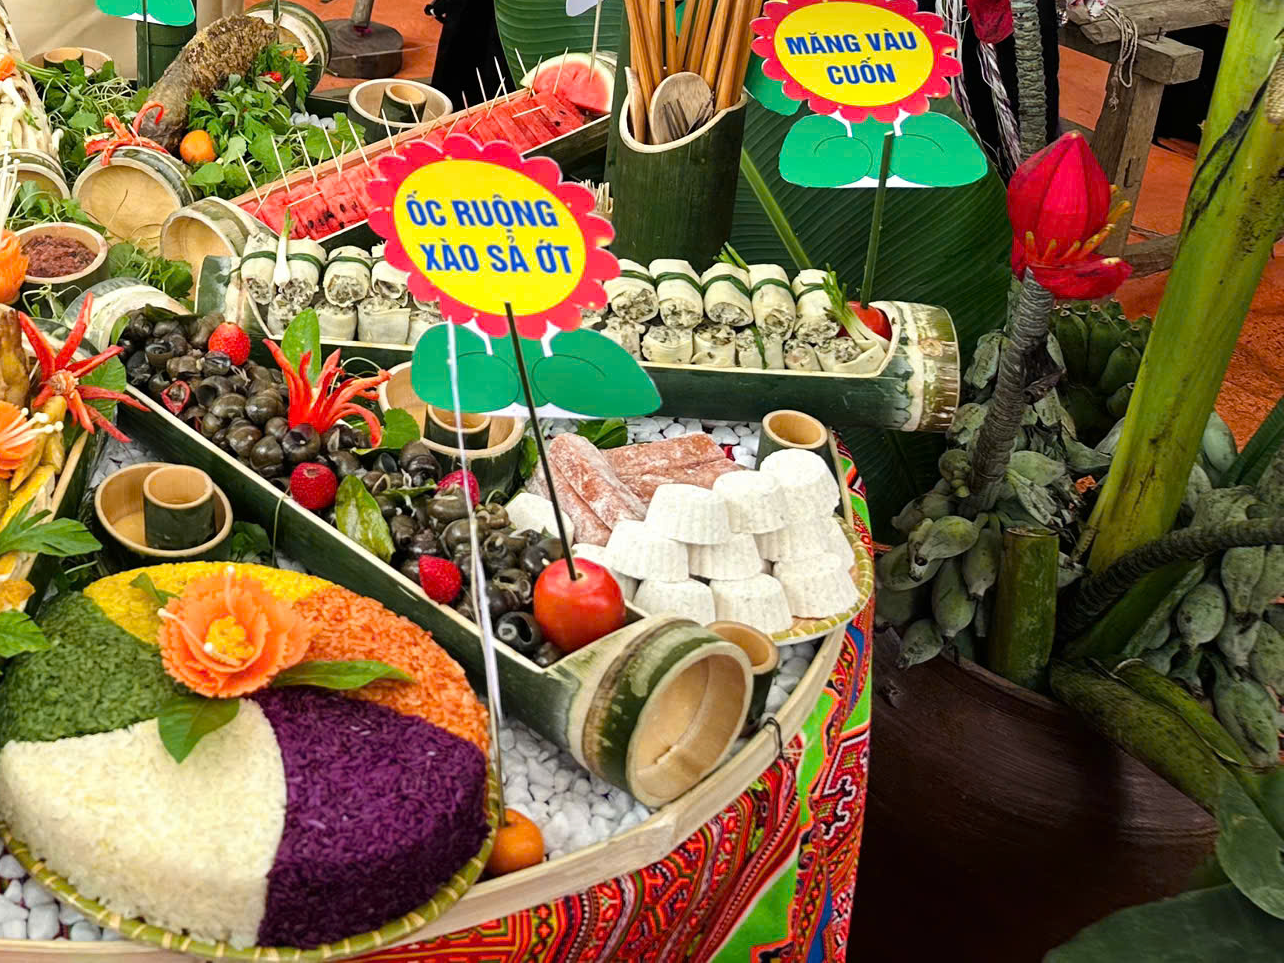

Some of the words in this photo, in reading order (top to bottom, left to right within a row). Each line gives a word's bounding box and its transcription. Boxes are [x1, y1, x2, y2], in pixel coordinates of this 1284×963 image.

[784, 31, 861, 56] MĂNG
[864, 28, 918, 52] VÀU
[826, 56, 897, 86] CUỐN
[405, 190, 447, 227] ỐC
[451, 193, 559, 233] RUỘNG
[419, 238, 480, 272] XÀO
[486, 235, 530, 273] SẢ
[535, 238, 572, 274] ỚT
